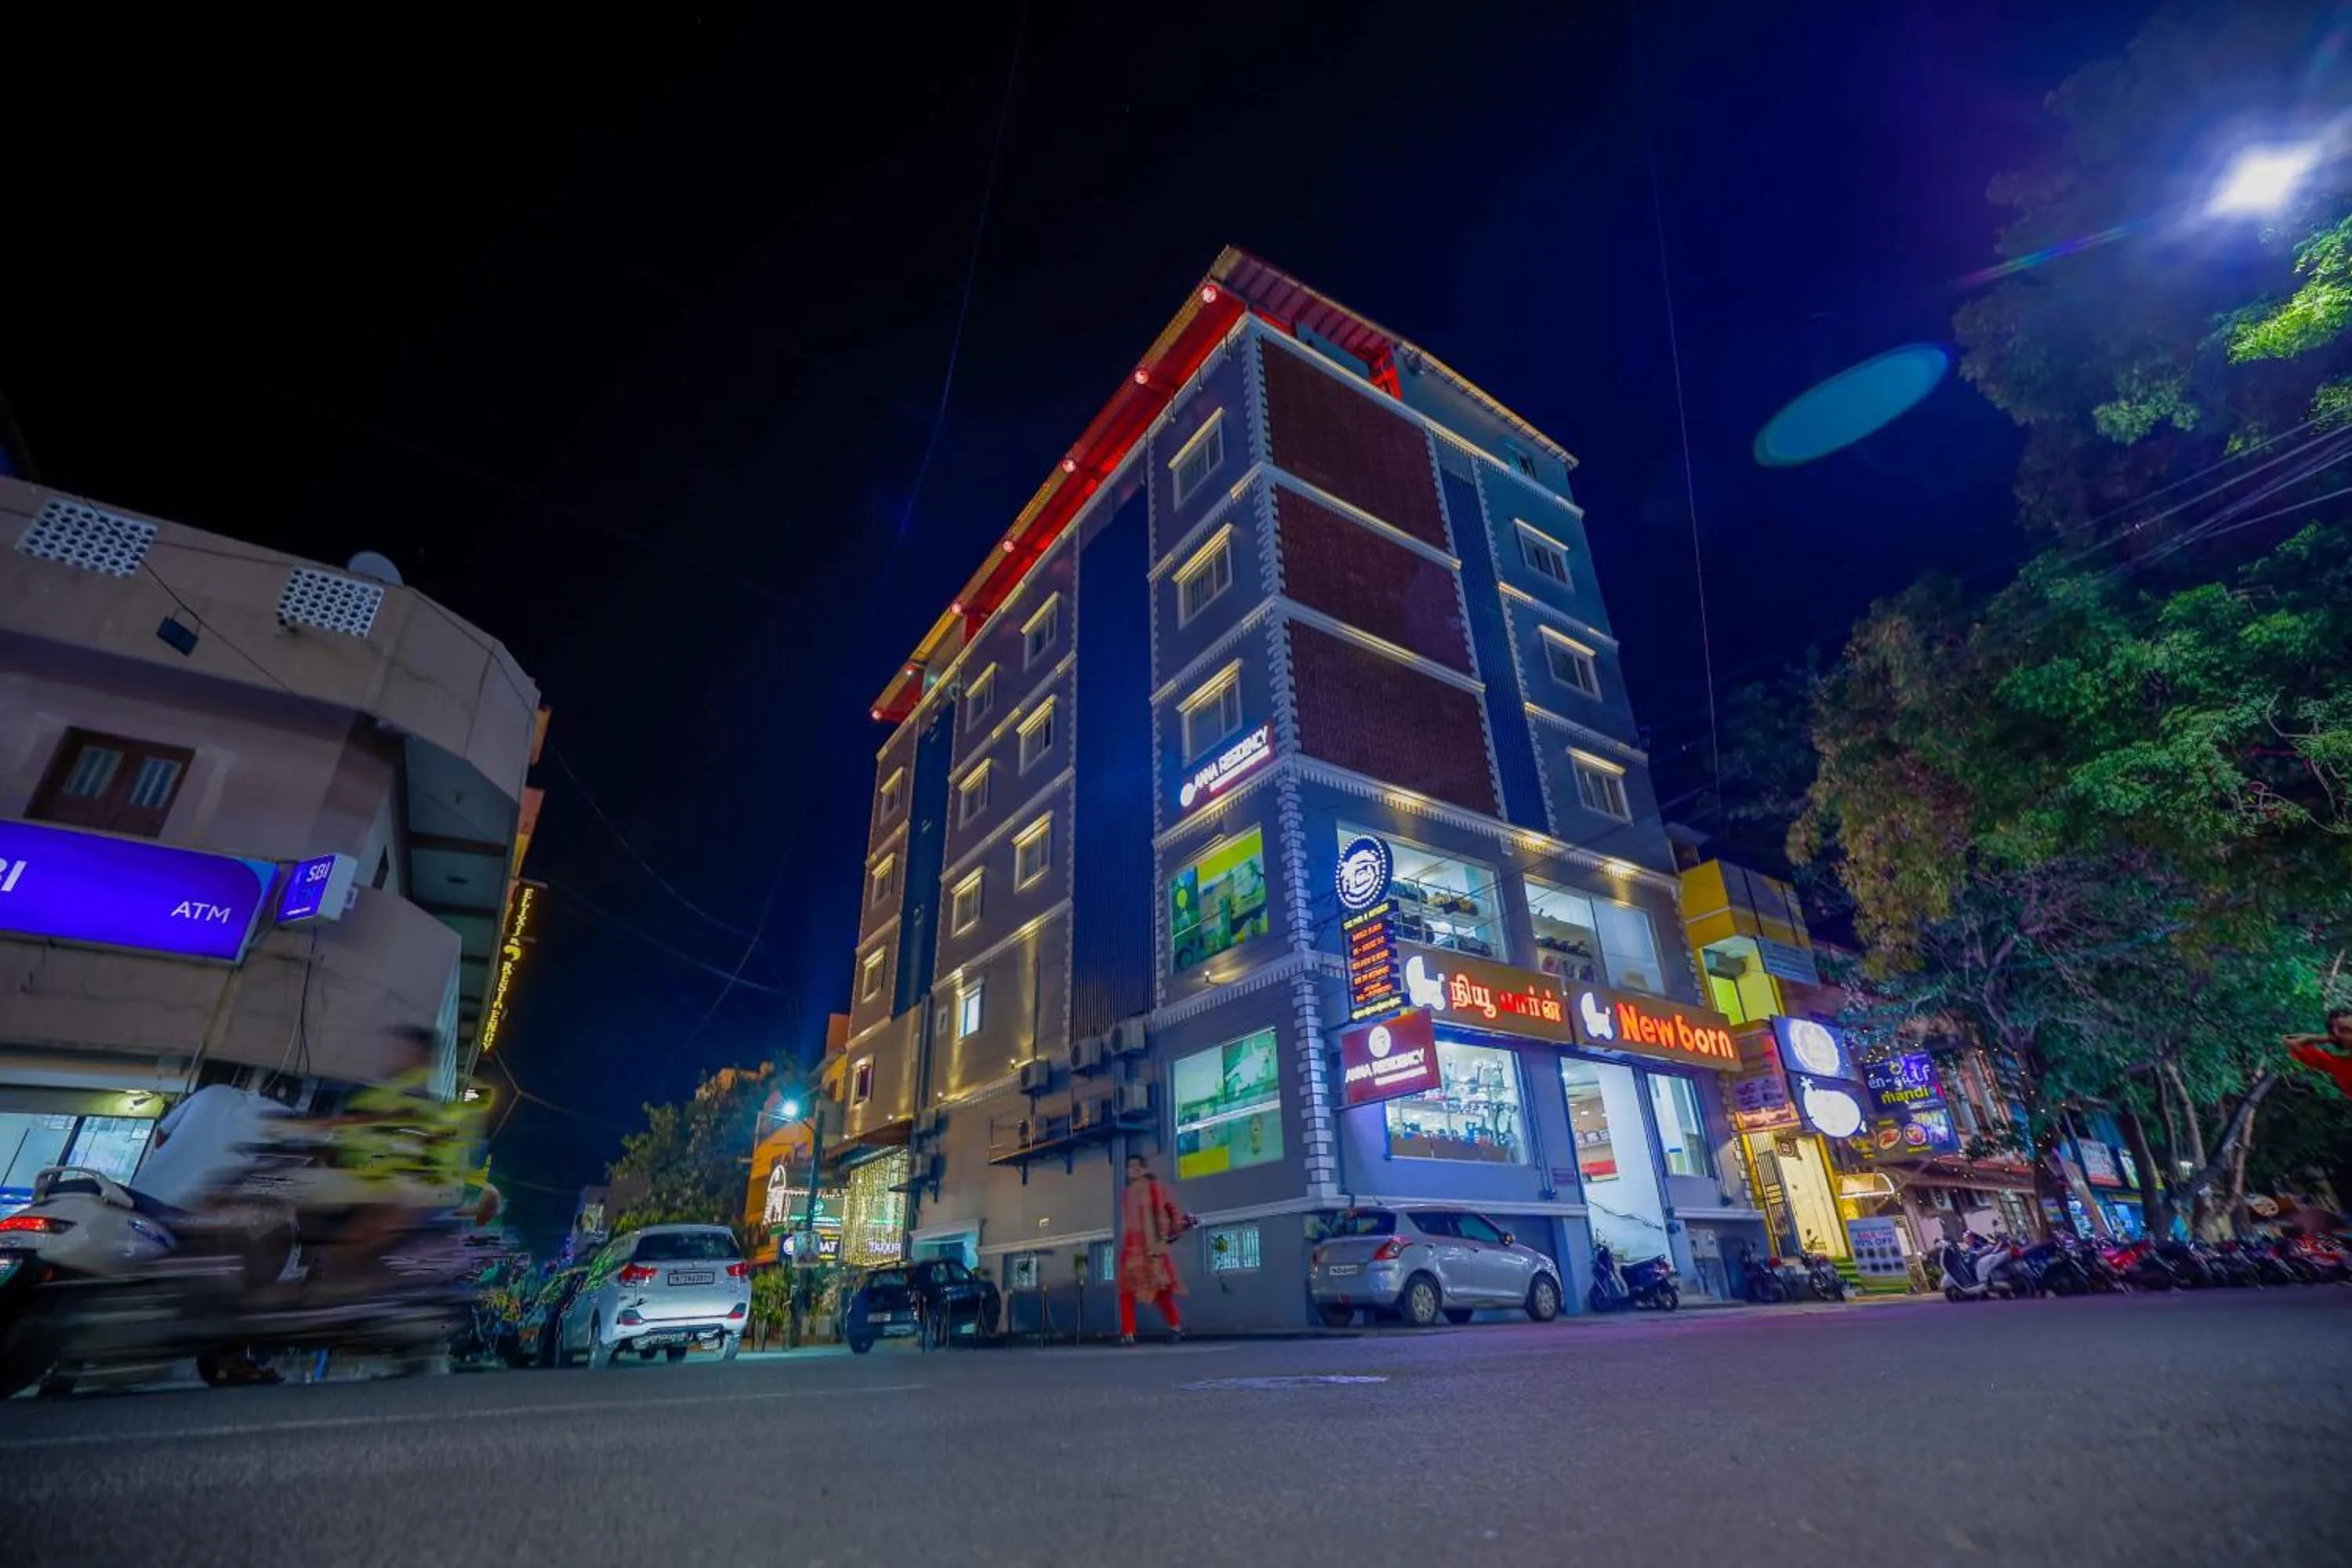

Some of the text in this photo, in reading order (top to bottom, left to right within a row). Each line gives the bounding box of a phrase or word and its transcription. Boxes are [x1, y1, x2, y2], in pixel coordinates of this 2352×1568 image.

[306, 862, 332, 882] SBI
[170, 901, 231, 924] ATM
[1449, 973, 1497, 1018] நியூ
[1881, 1084, 1929, 1105] mandi
